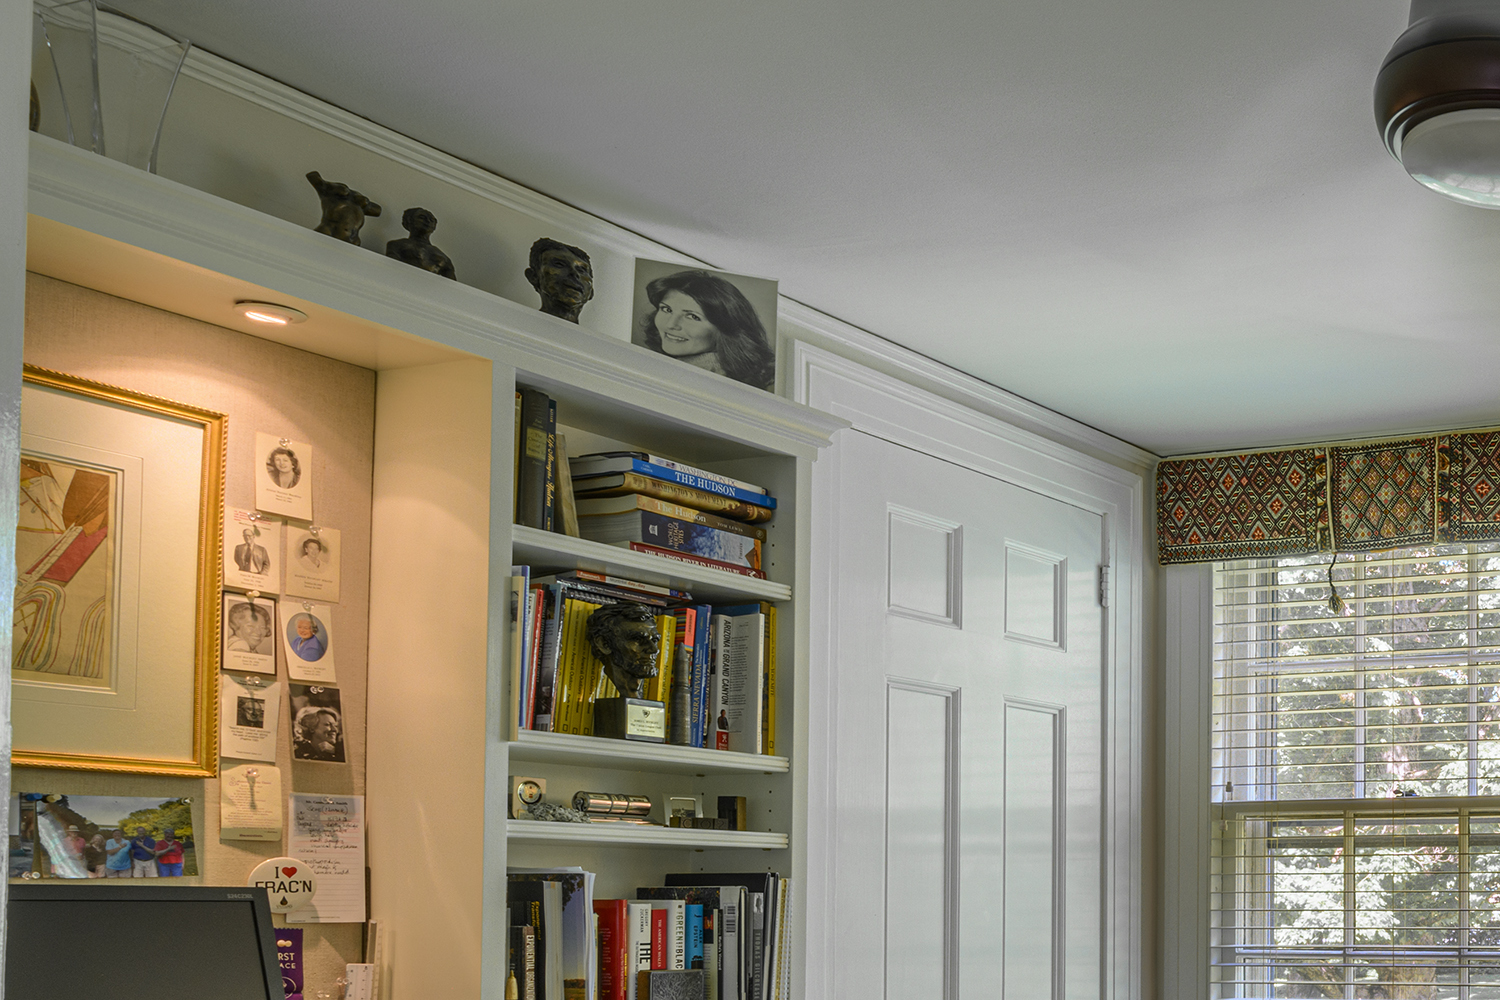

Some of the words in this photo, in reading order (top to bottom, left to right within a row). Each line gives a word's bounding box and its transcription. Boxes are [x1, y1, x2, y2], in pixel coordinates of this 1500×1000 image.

[675, 472, 696, 486] THE
[697, 478, 736, 496] HUDSON
[654, 500, 672, 514] The
[675, 508, 707, 523] Hudson
[658, 552, 682, 562] HUDSON
[682, 558, 699, 566] RIVER
[707, 563, 740, 575] LITERATURE
[723, 619, 732, 648] ARIZONA
[722, 653, 731, 677] GRAND
[694, 664, 702, 695] NEVADA
[721, 679, 730, 706] CANYON
[692, 695, 700, 724] SIERRA
[275, 866, 280, 878] I
[676, 915, 684, 941] GREEN
[278, 952, 295, 961] RST
[526, 934, 535, 971] EXPONENTIAL
[640, 942, 650, 965] THE
[280, 962, 296, 970] ACE
